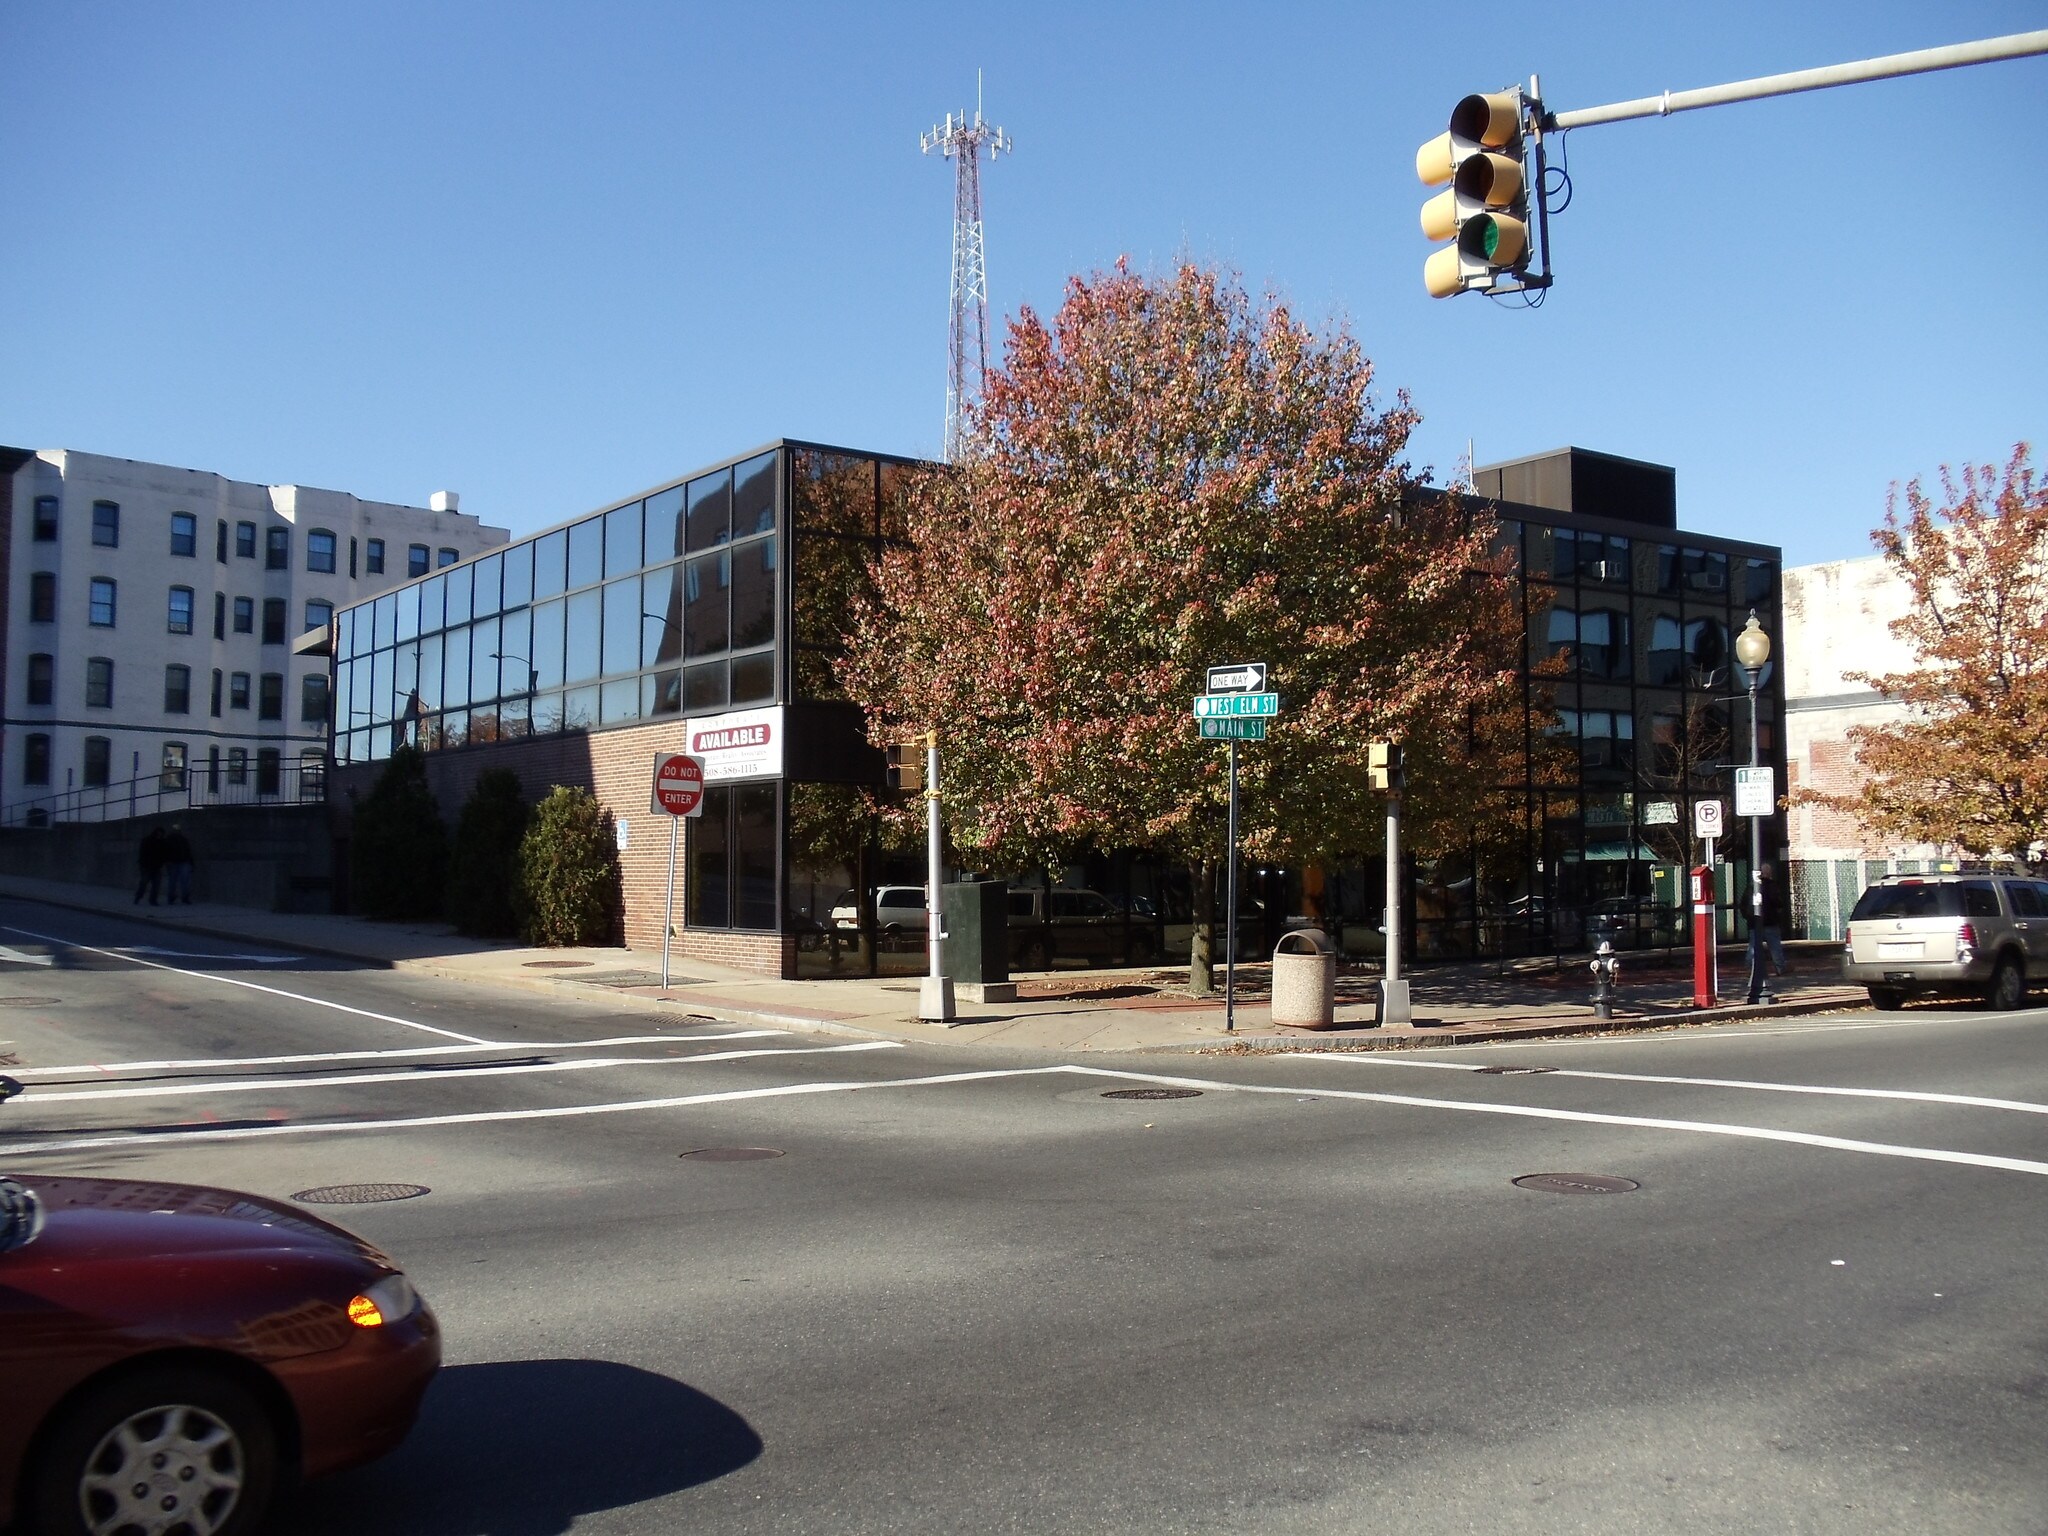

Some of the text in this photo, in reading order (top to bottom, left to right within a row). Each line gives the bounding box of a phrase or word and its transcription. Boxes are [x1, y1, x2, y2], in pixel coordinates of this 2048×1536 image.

[1212, 674, 1248, 687] ONE WAY
[1210, 696, 1275, 715] WEST ELM ST
[1219, 720, 1262, 737] MAIN ST
[699, 727, 764, 750] AVAILABLE
[664, 766, 698, 777] DO NOT
[665, 793, 692, 804] ENTER
